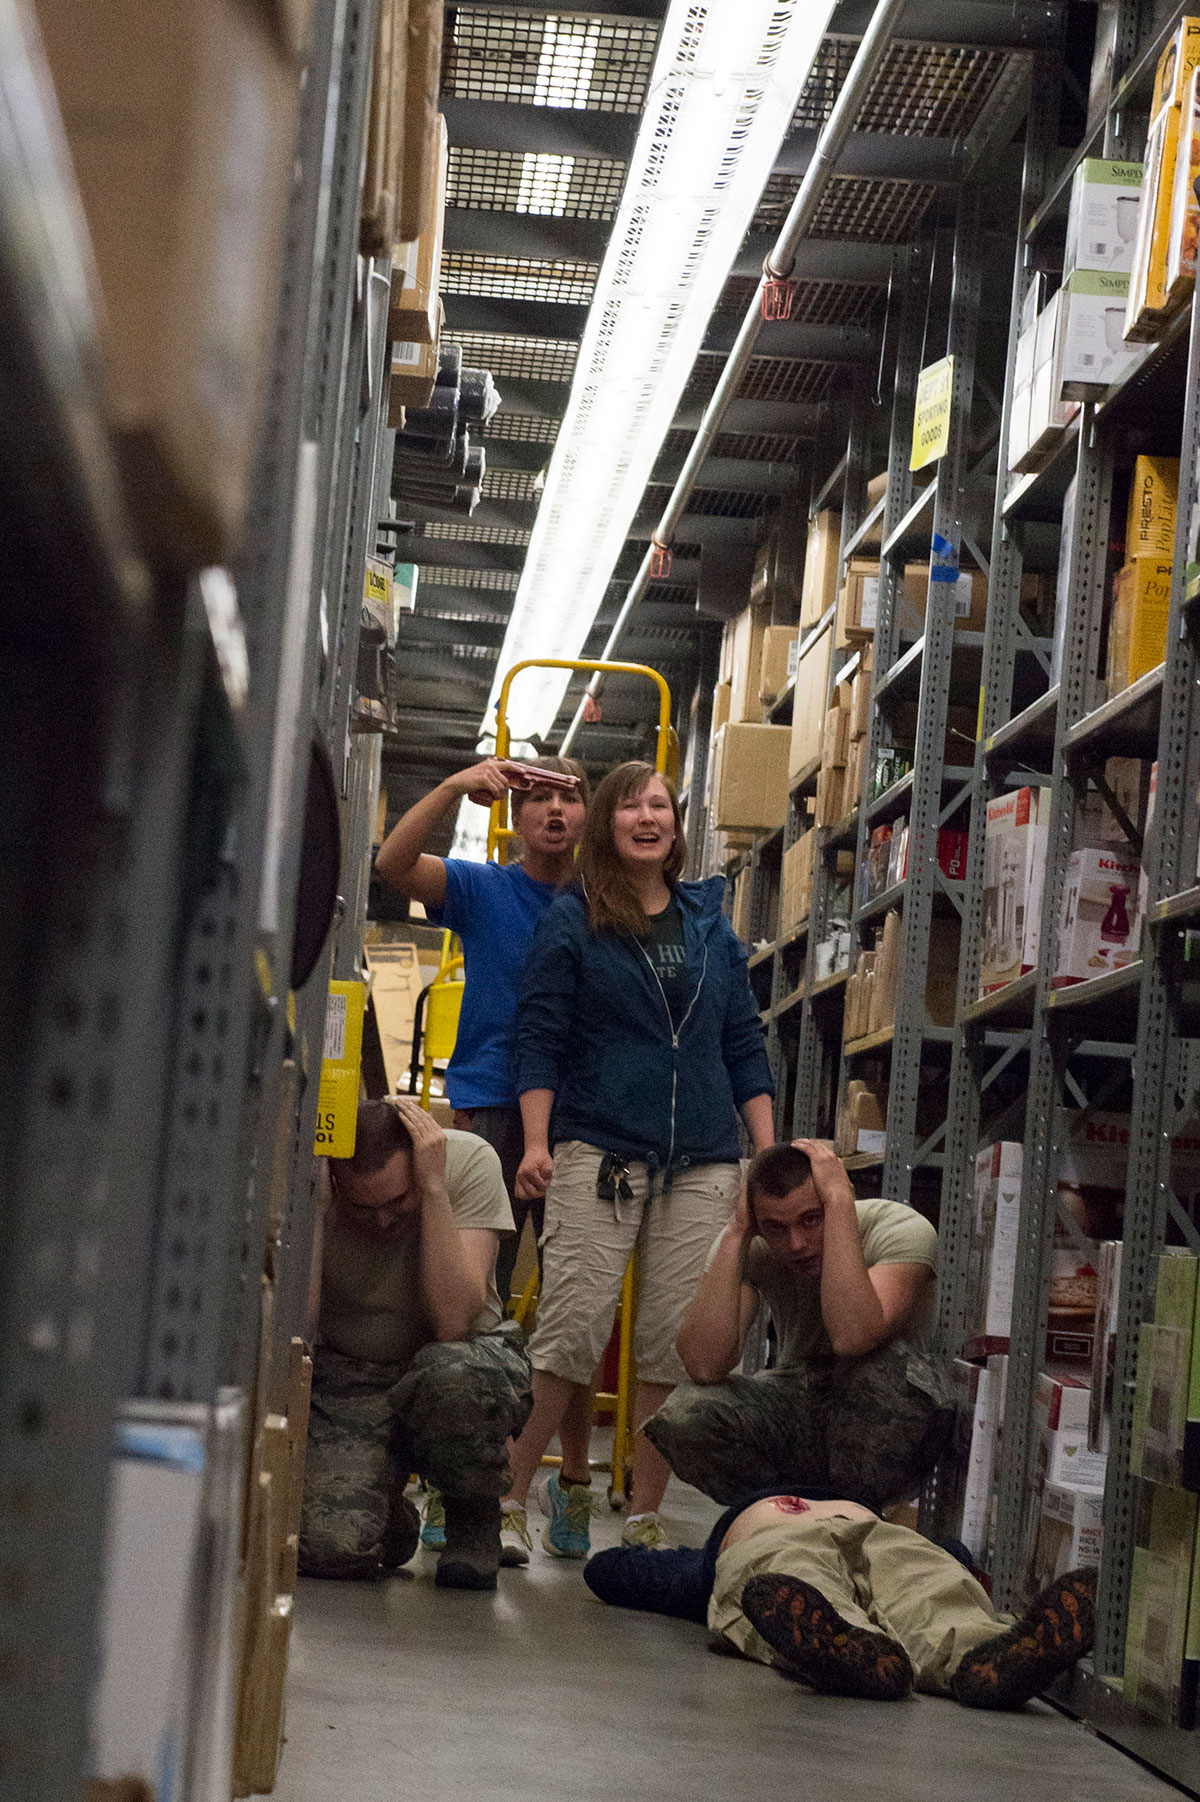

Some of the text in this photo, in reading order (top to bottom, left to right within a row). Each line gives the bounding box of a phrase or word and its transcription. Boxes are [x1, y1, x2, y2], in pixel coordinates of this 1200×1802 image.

[917, 399, 948, 426] SPORTING
[920, 424, 942, 446] GOODS
[1140, 475, 1153, 541] PRESTO
